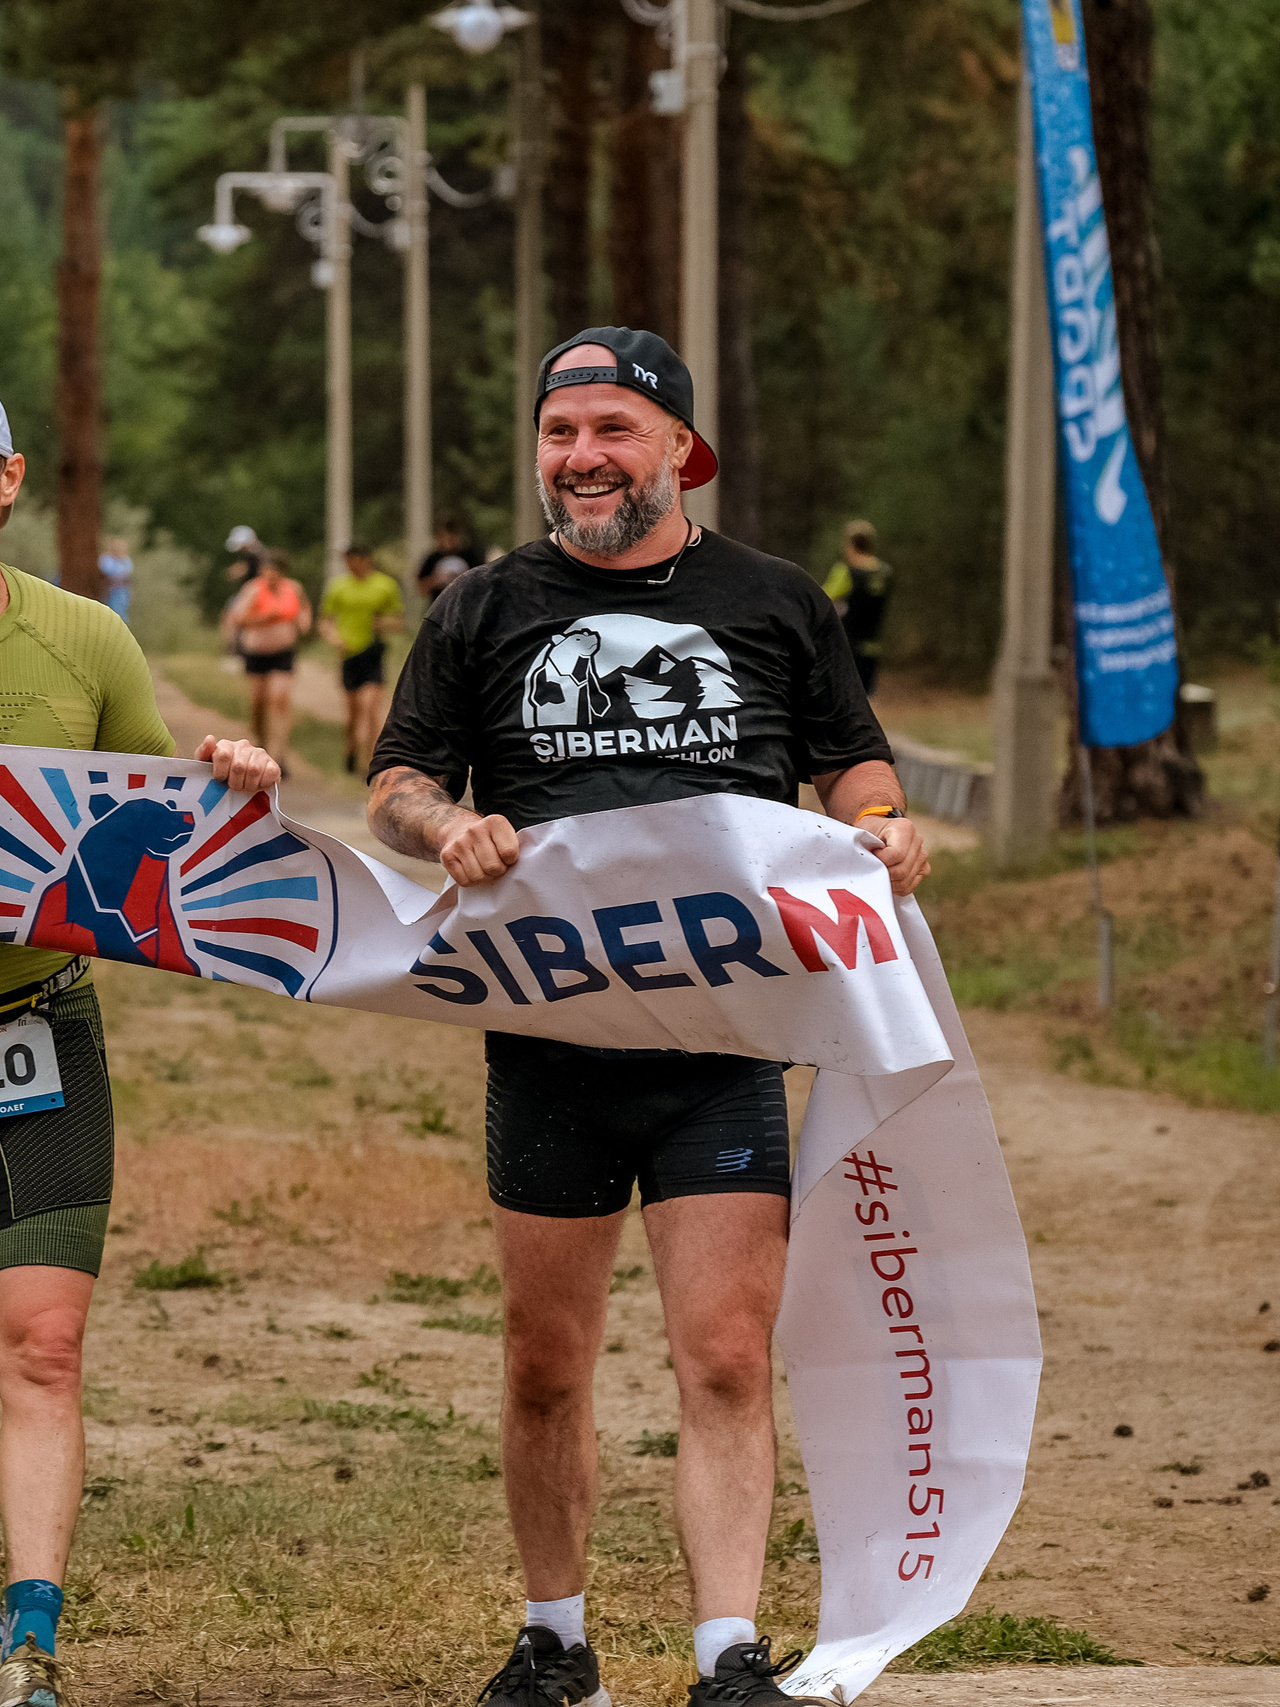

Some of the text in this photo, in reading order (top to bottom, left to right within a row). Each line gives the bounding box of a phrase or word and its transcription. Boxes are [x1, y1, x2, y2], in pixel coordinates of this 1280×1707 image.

[631, 363, 659, 389] TYR
[529, 714, 738, 758] SIBERMAN
[409, 886, 899, 1006] SIBERM
[0, 1103, 25, 1114] ОЛЕГ
[841, 1149, 945, 1584] #siberman515
